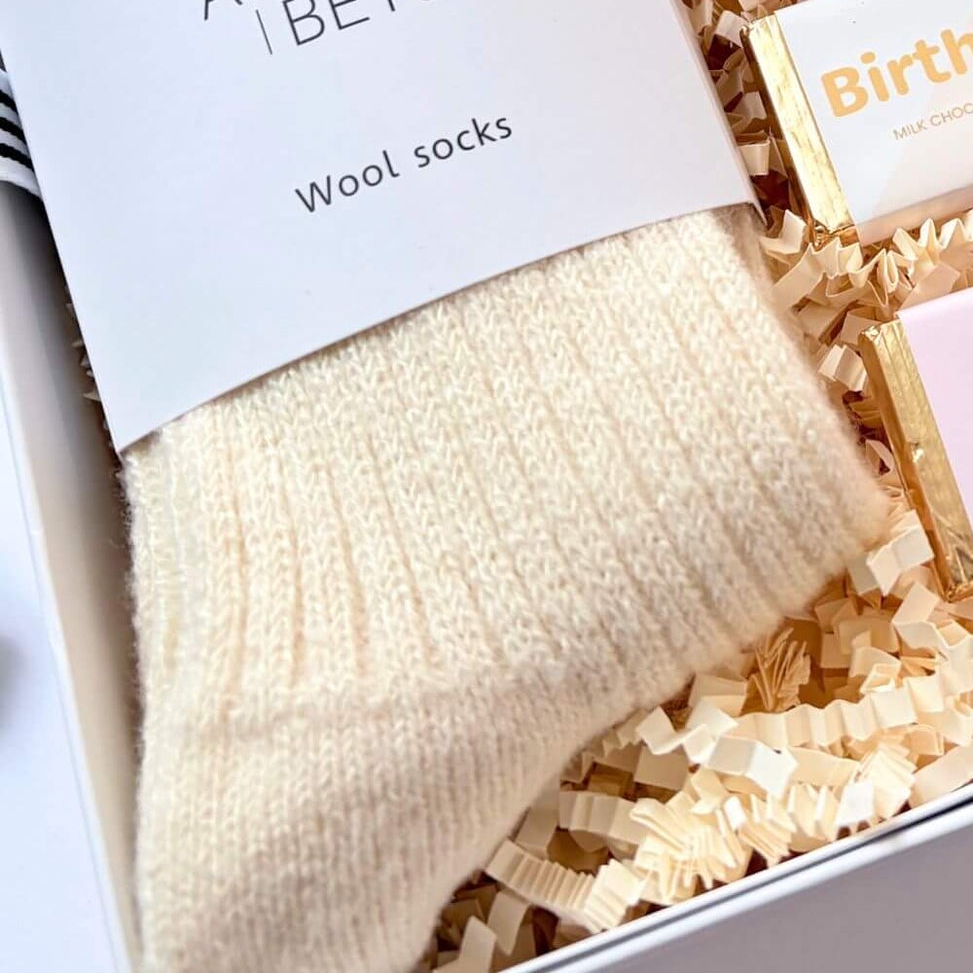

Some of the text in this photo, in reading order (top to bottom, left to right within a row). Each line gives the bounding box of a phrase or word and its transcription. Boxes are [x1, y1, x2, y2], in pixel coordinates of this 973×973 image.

[893, 119, 926, 141] MILK
[295, 117, 512, 213] Wool socks
